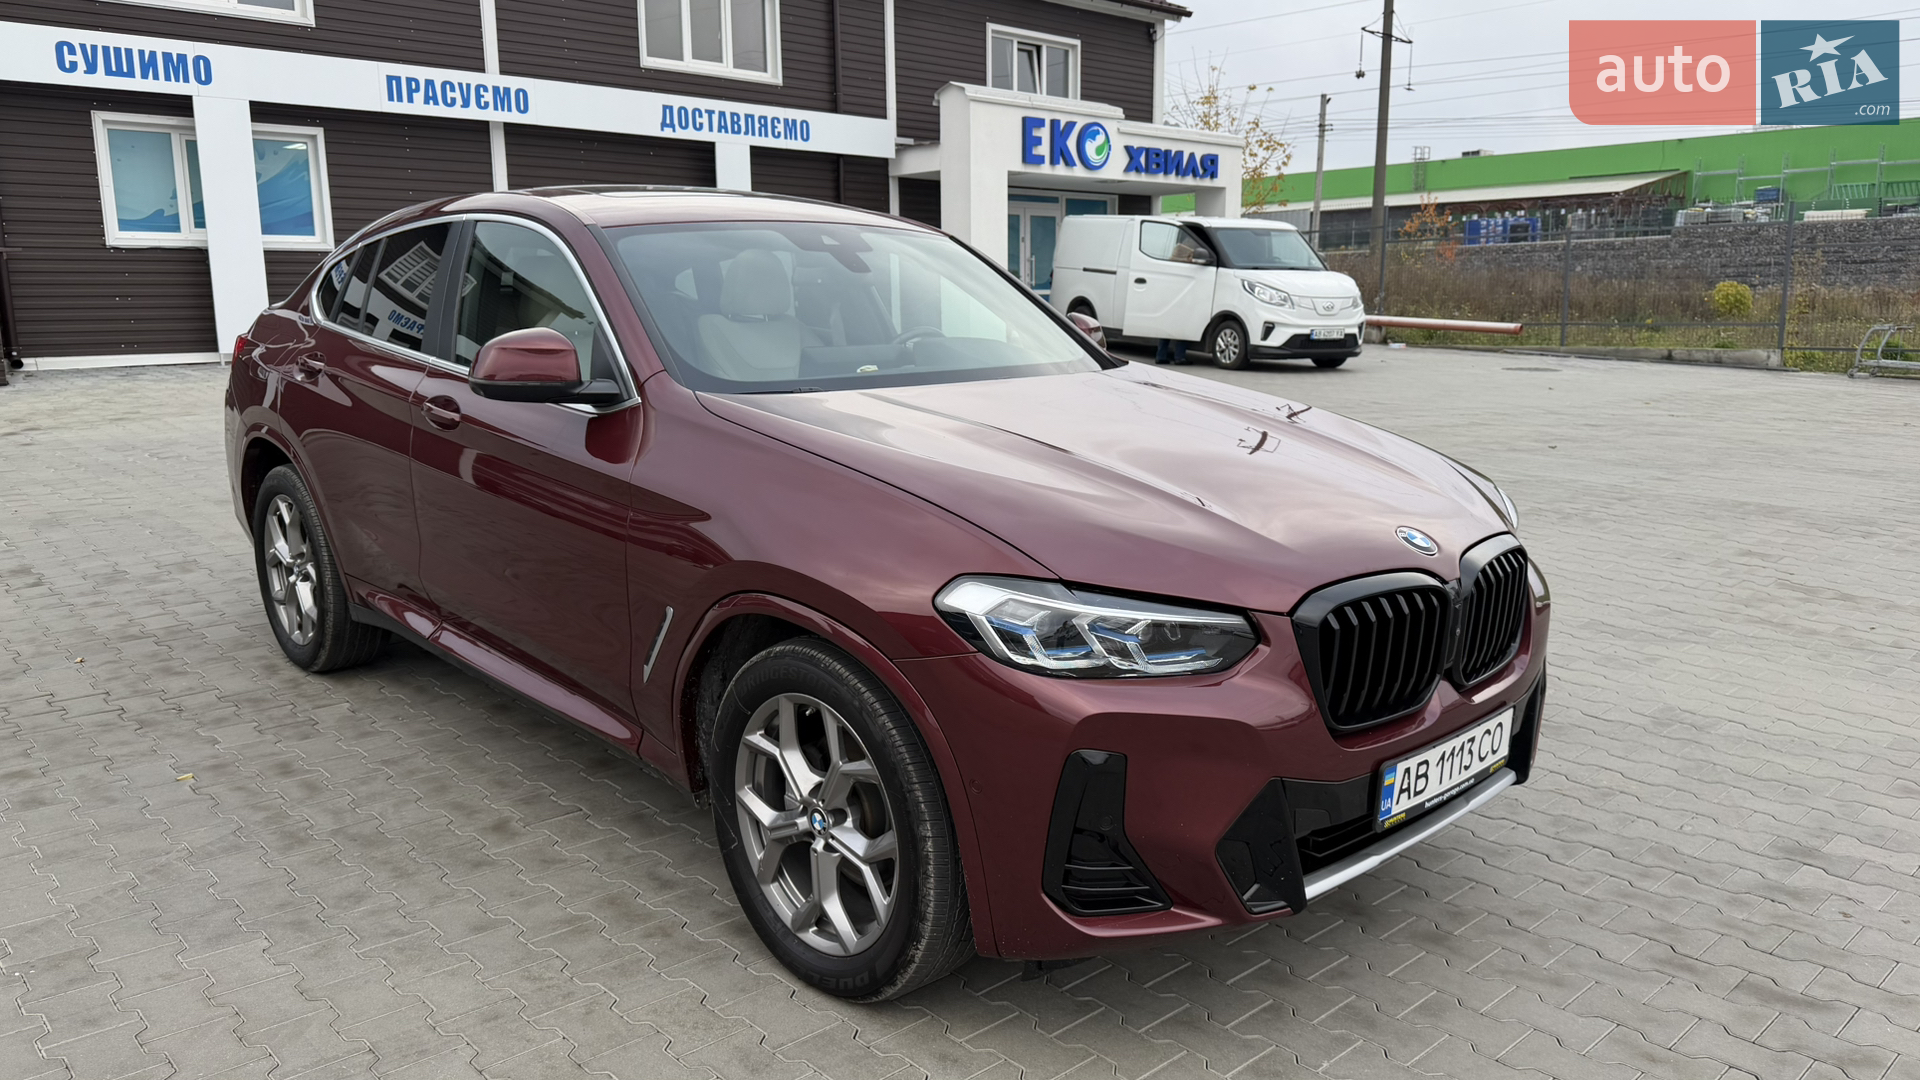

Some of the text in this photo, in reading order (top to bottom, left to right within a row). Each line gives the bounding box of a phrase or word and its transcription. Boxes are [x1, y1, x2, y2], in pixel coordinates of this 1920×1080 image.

[55, 40, 213, 86] СУШИМО
[386, 74, 530, 115] ПРАСУЄМО
[660, 104, 811, 142] ДОСТАВЛЯЄМО
[1123, 145, 1219, 179] ХВИЛЯ
[1396, 721, 1503, 805] AB 1113 CO
[1380, 797, 1391, 811] UA
